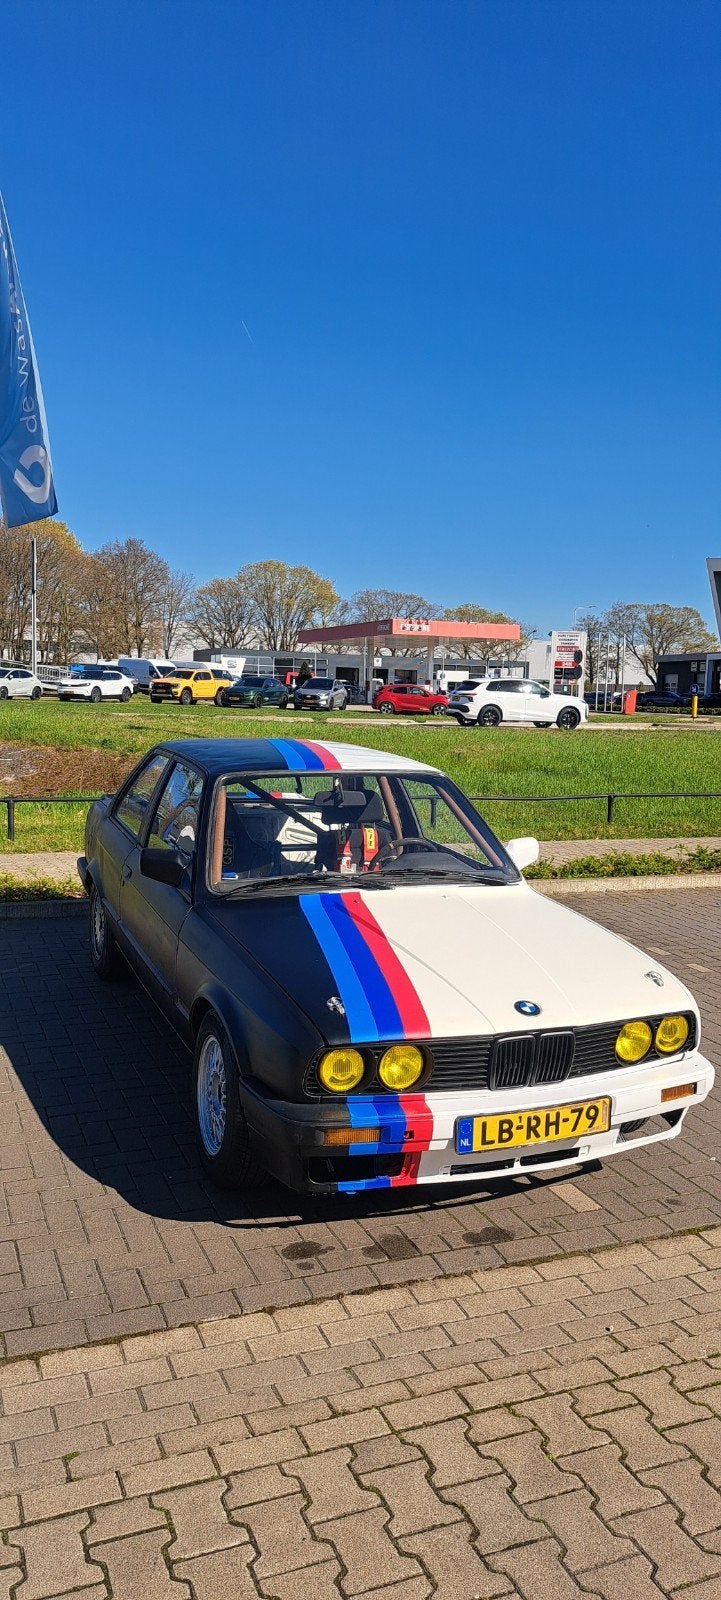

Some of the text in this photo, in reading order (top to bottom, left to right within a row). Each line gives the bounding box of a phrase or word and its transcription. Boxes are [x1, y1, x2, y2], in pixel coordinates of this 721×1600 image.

[19, 395, 39, 434] de
[222, 839, 233, 865] QSP
[480, 1104, 600, 1146] LB-RH-79
[460, 1138, 472, 1147] NL
